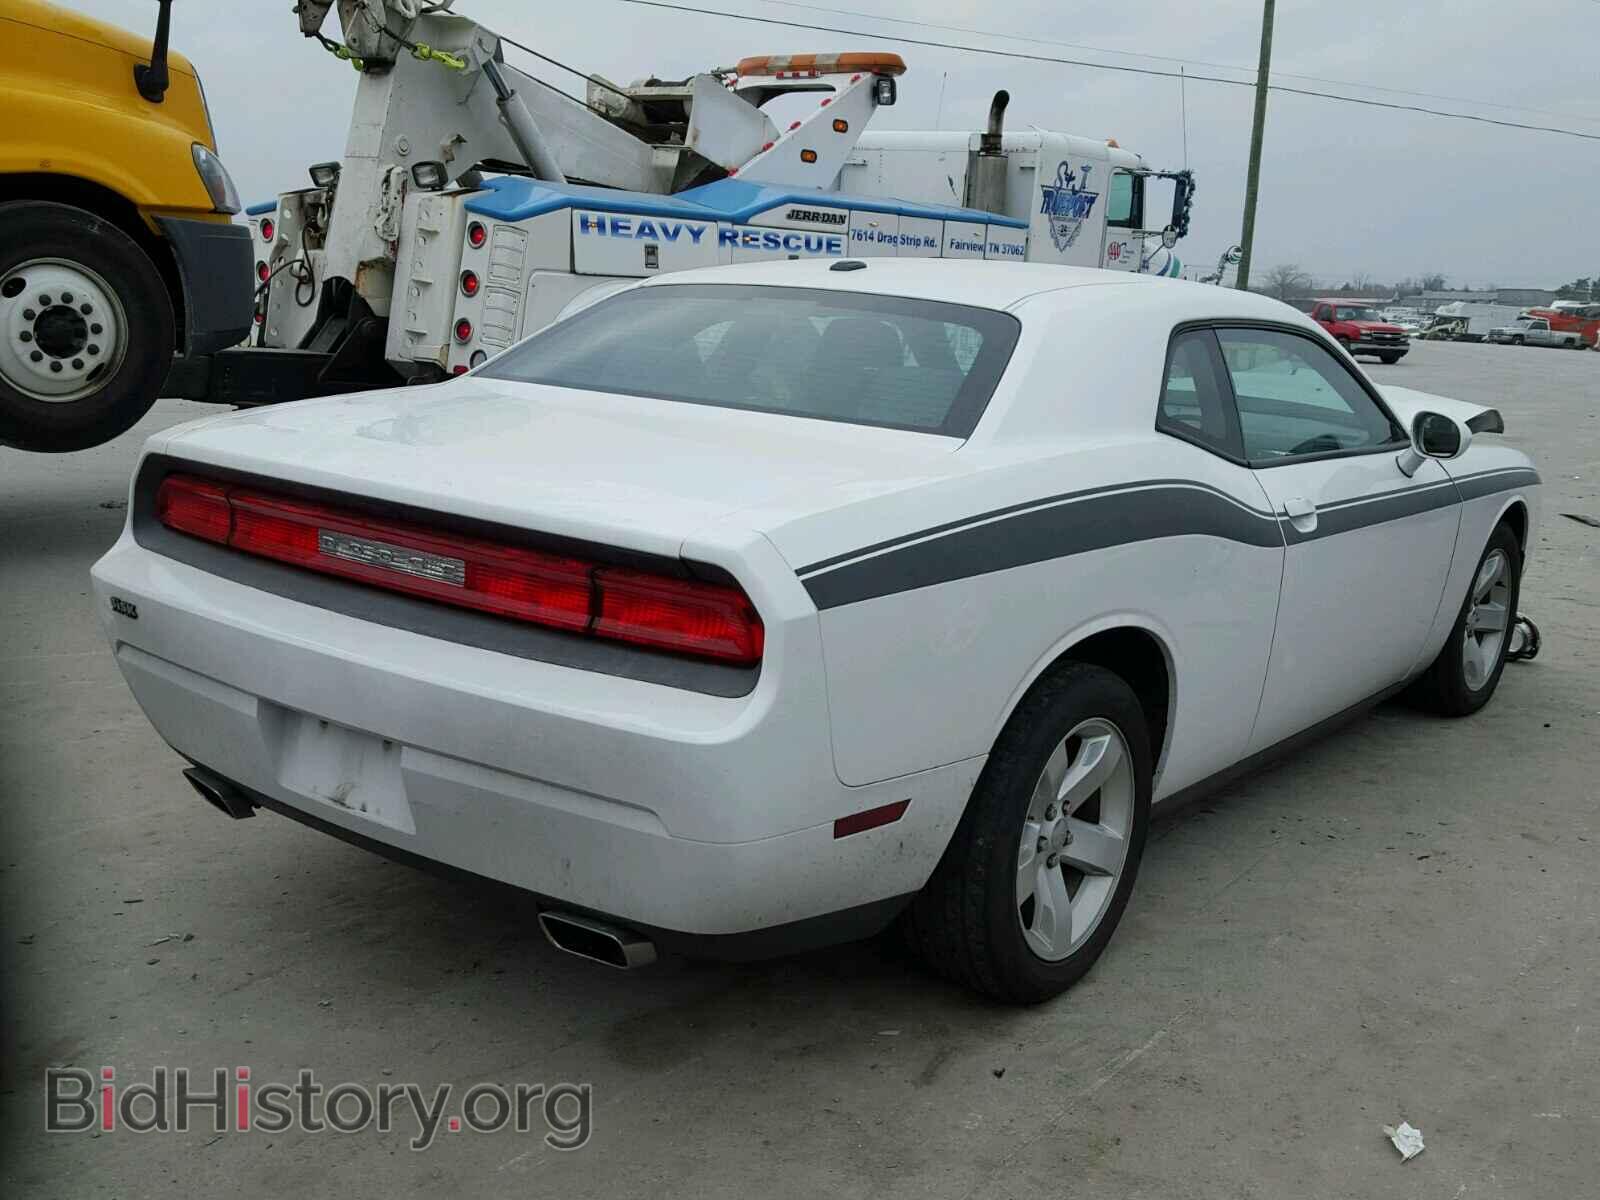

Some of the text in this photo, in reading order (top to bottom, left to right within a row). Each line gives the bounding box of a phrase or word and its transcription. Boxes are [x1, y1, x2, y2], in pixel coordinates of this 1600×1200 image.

[786, 209, 847, 225] JERR-DAN
[580, 213, 842, 256] HEAVY RESCUE
[851, 229, 938, 249] 7614 Drag Strip Rd.
[989, 243, 999, 253] TN
[1001, 244, 1025, 256] 37062
